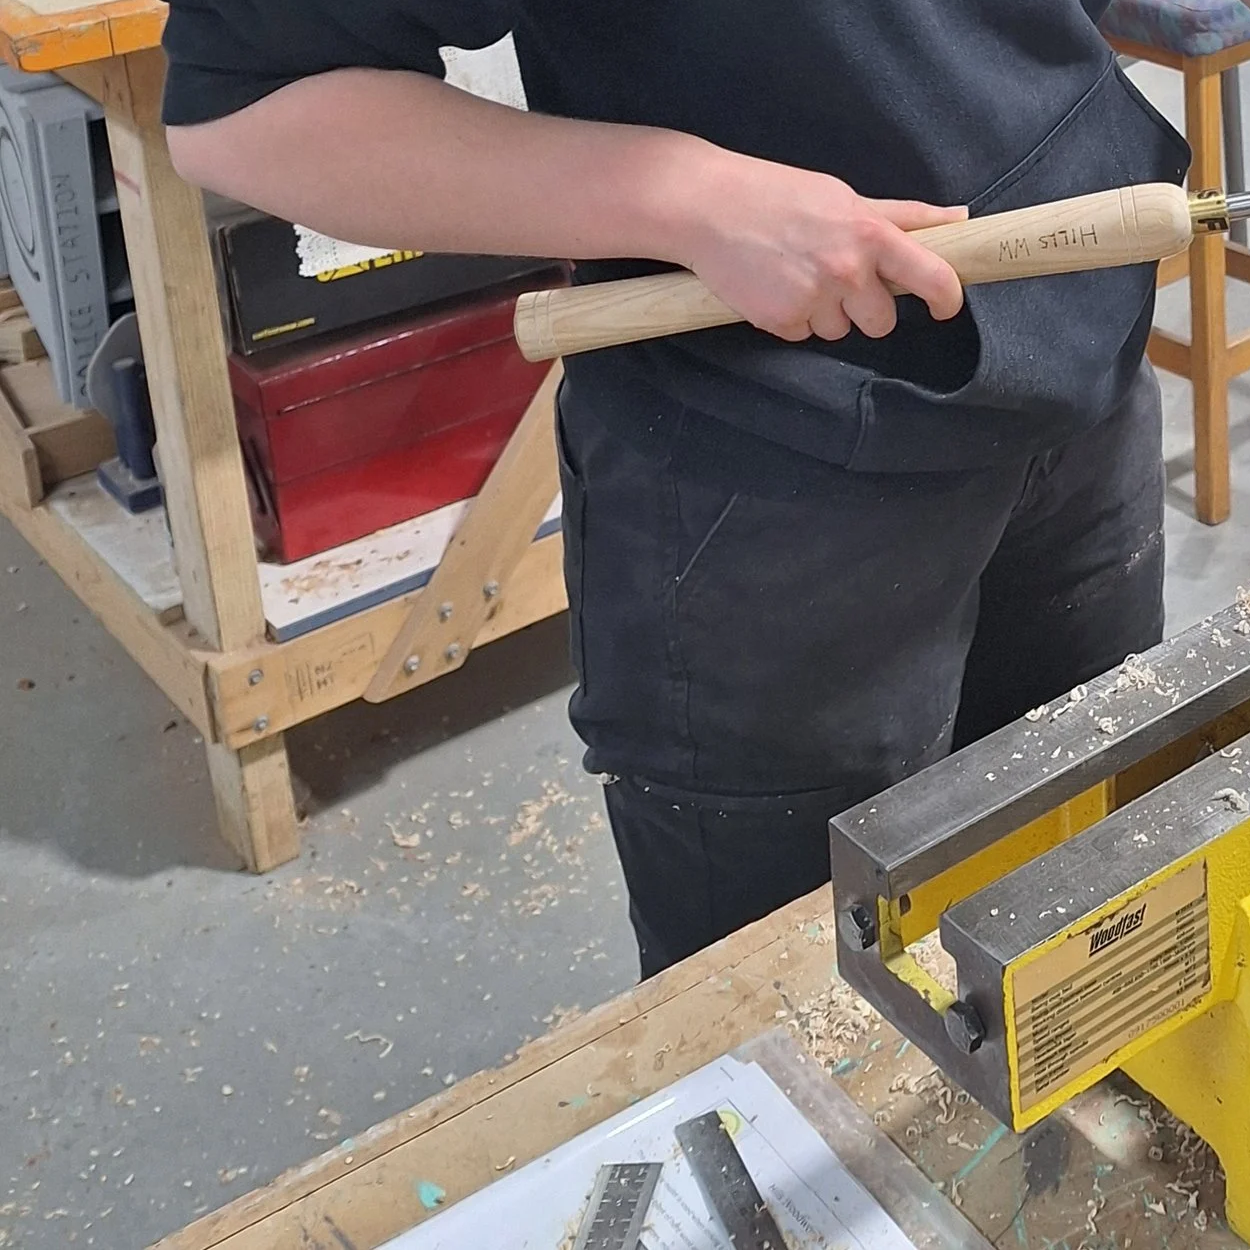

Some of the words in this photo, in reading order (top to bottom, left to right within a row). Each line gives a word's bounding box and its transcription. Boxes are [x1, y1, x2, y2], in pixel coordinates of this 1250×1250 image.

[51, 173, 91, 285] STATION
[1038, 223, 1099, 250] HILLS
[1089, 904, 1147, 954] Woodfast
